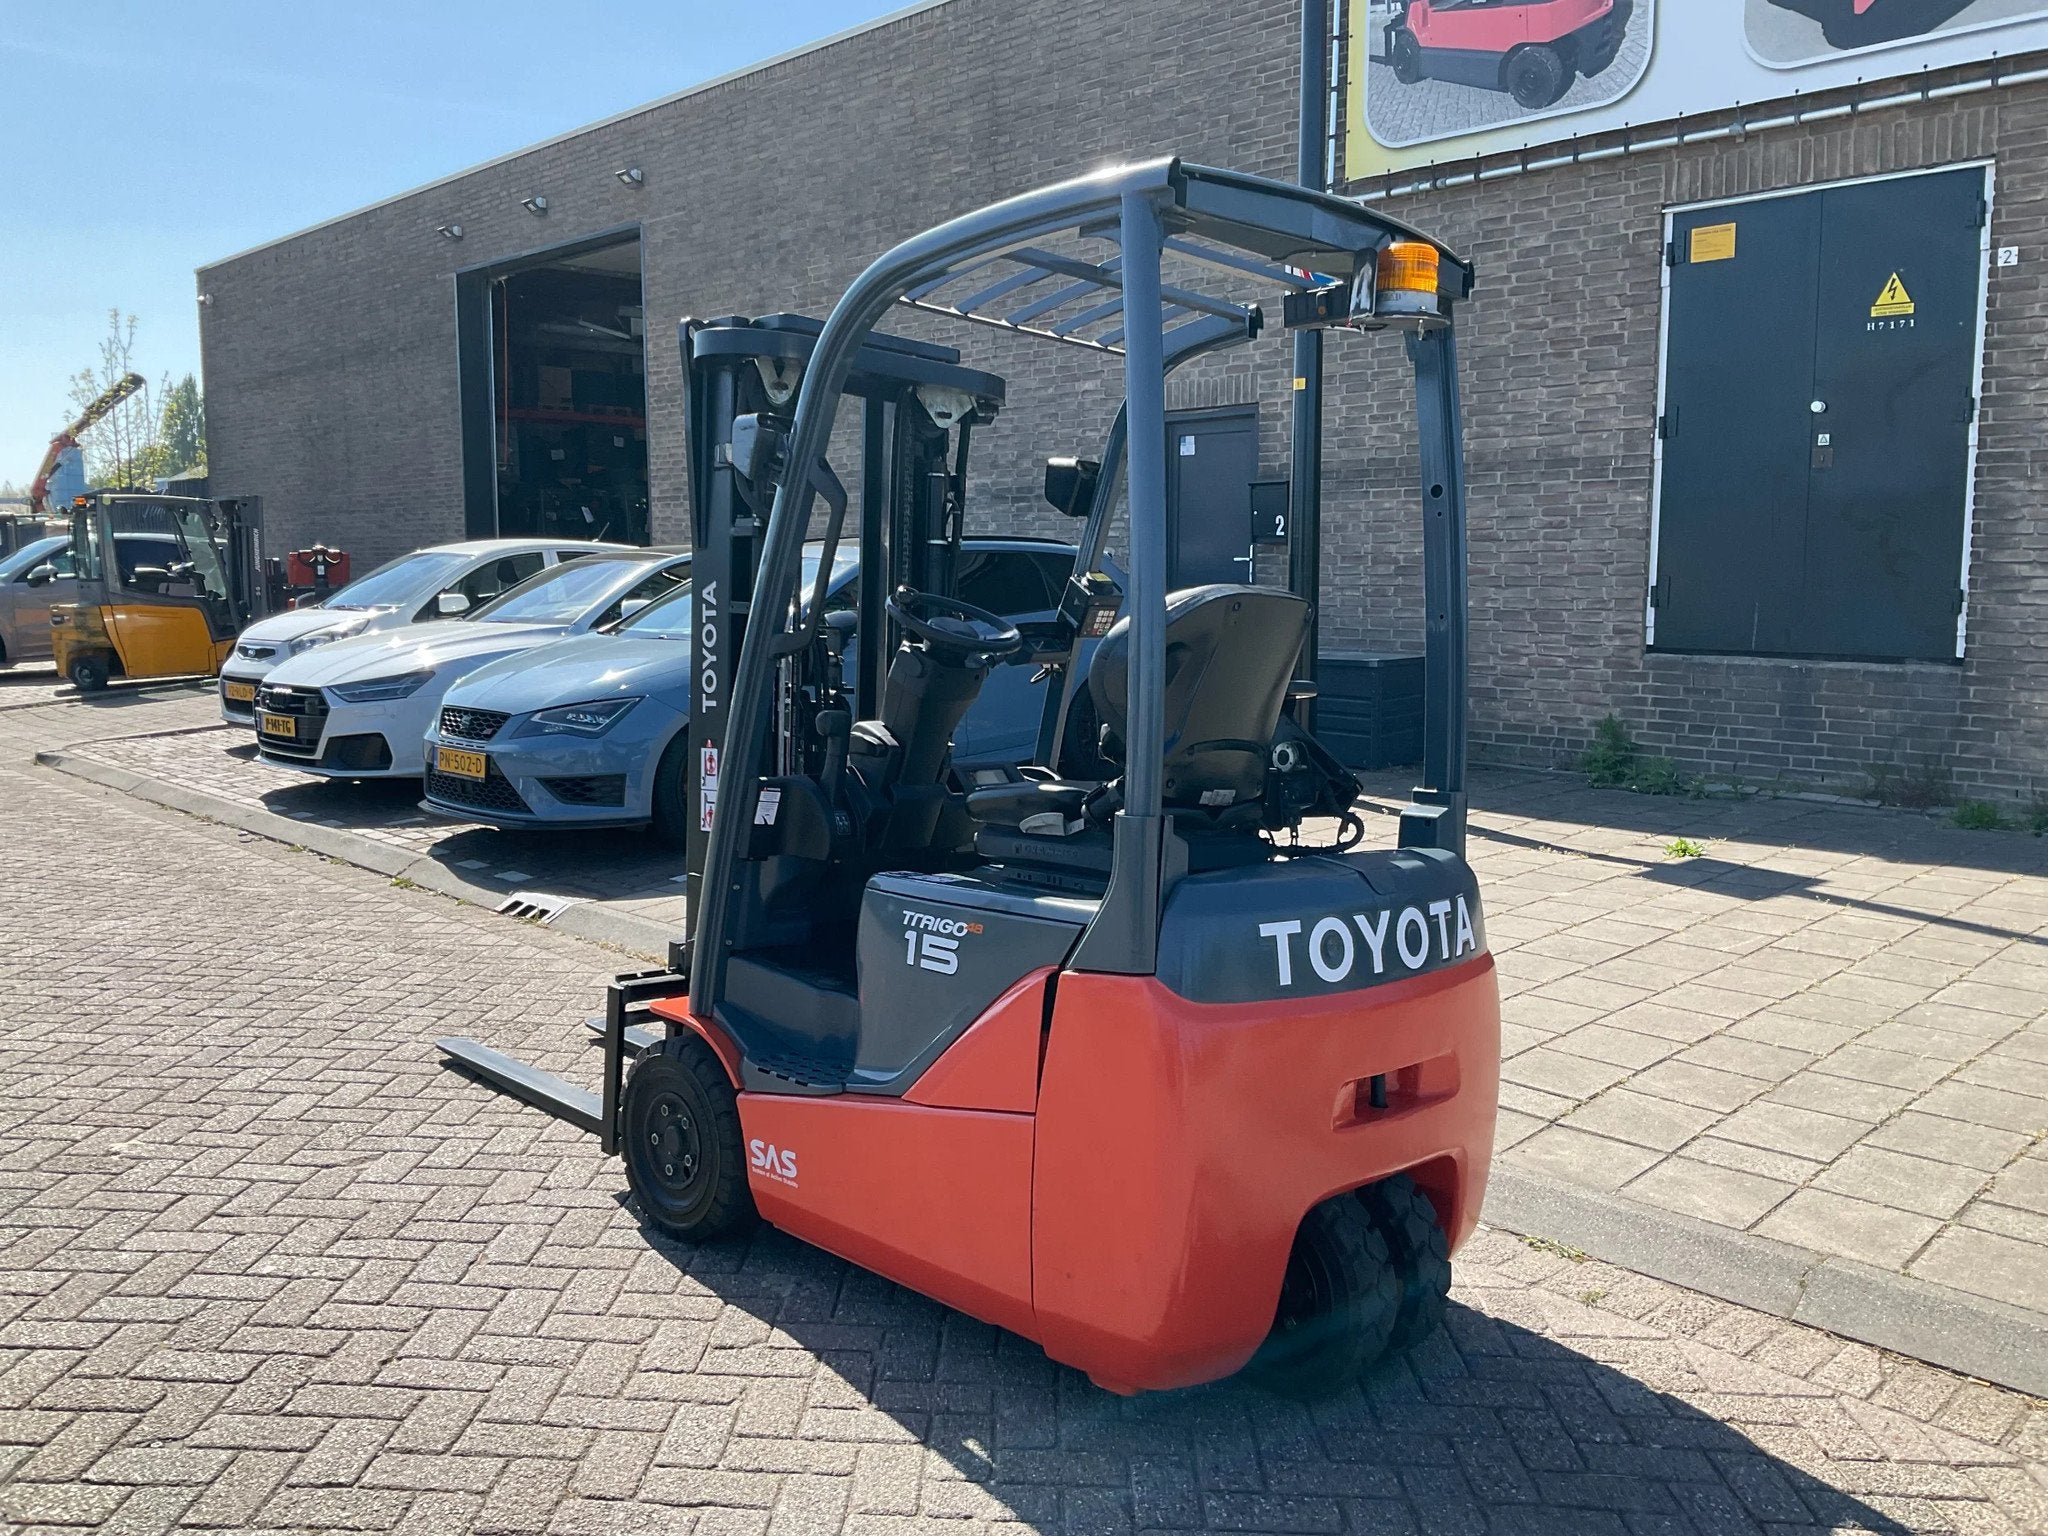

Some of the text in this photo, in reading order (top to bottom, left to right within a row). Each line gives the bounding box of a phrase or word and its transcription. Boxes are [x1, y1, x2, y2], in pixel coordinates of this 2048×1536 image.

[2003, 249, 2012, 264] 2
[1275, 514, 1285, 536] 2
[702, 580, 717, 714] TOYOTA
[440, 751, 483, 774] PN-502-D
[904, 930, 959, 975] 15
[1258, 896, 1477, 986] TOYOTA
[750, 1139, 798, 1178] SAS
